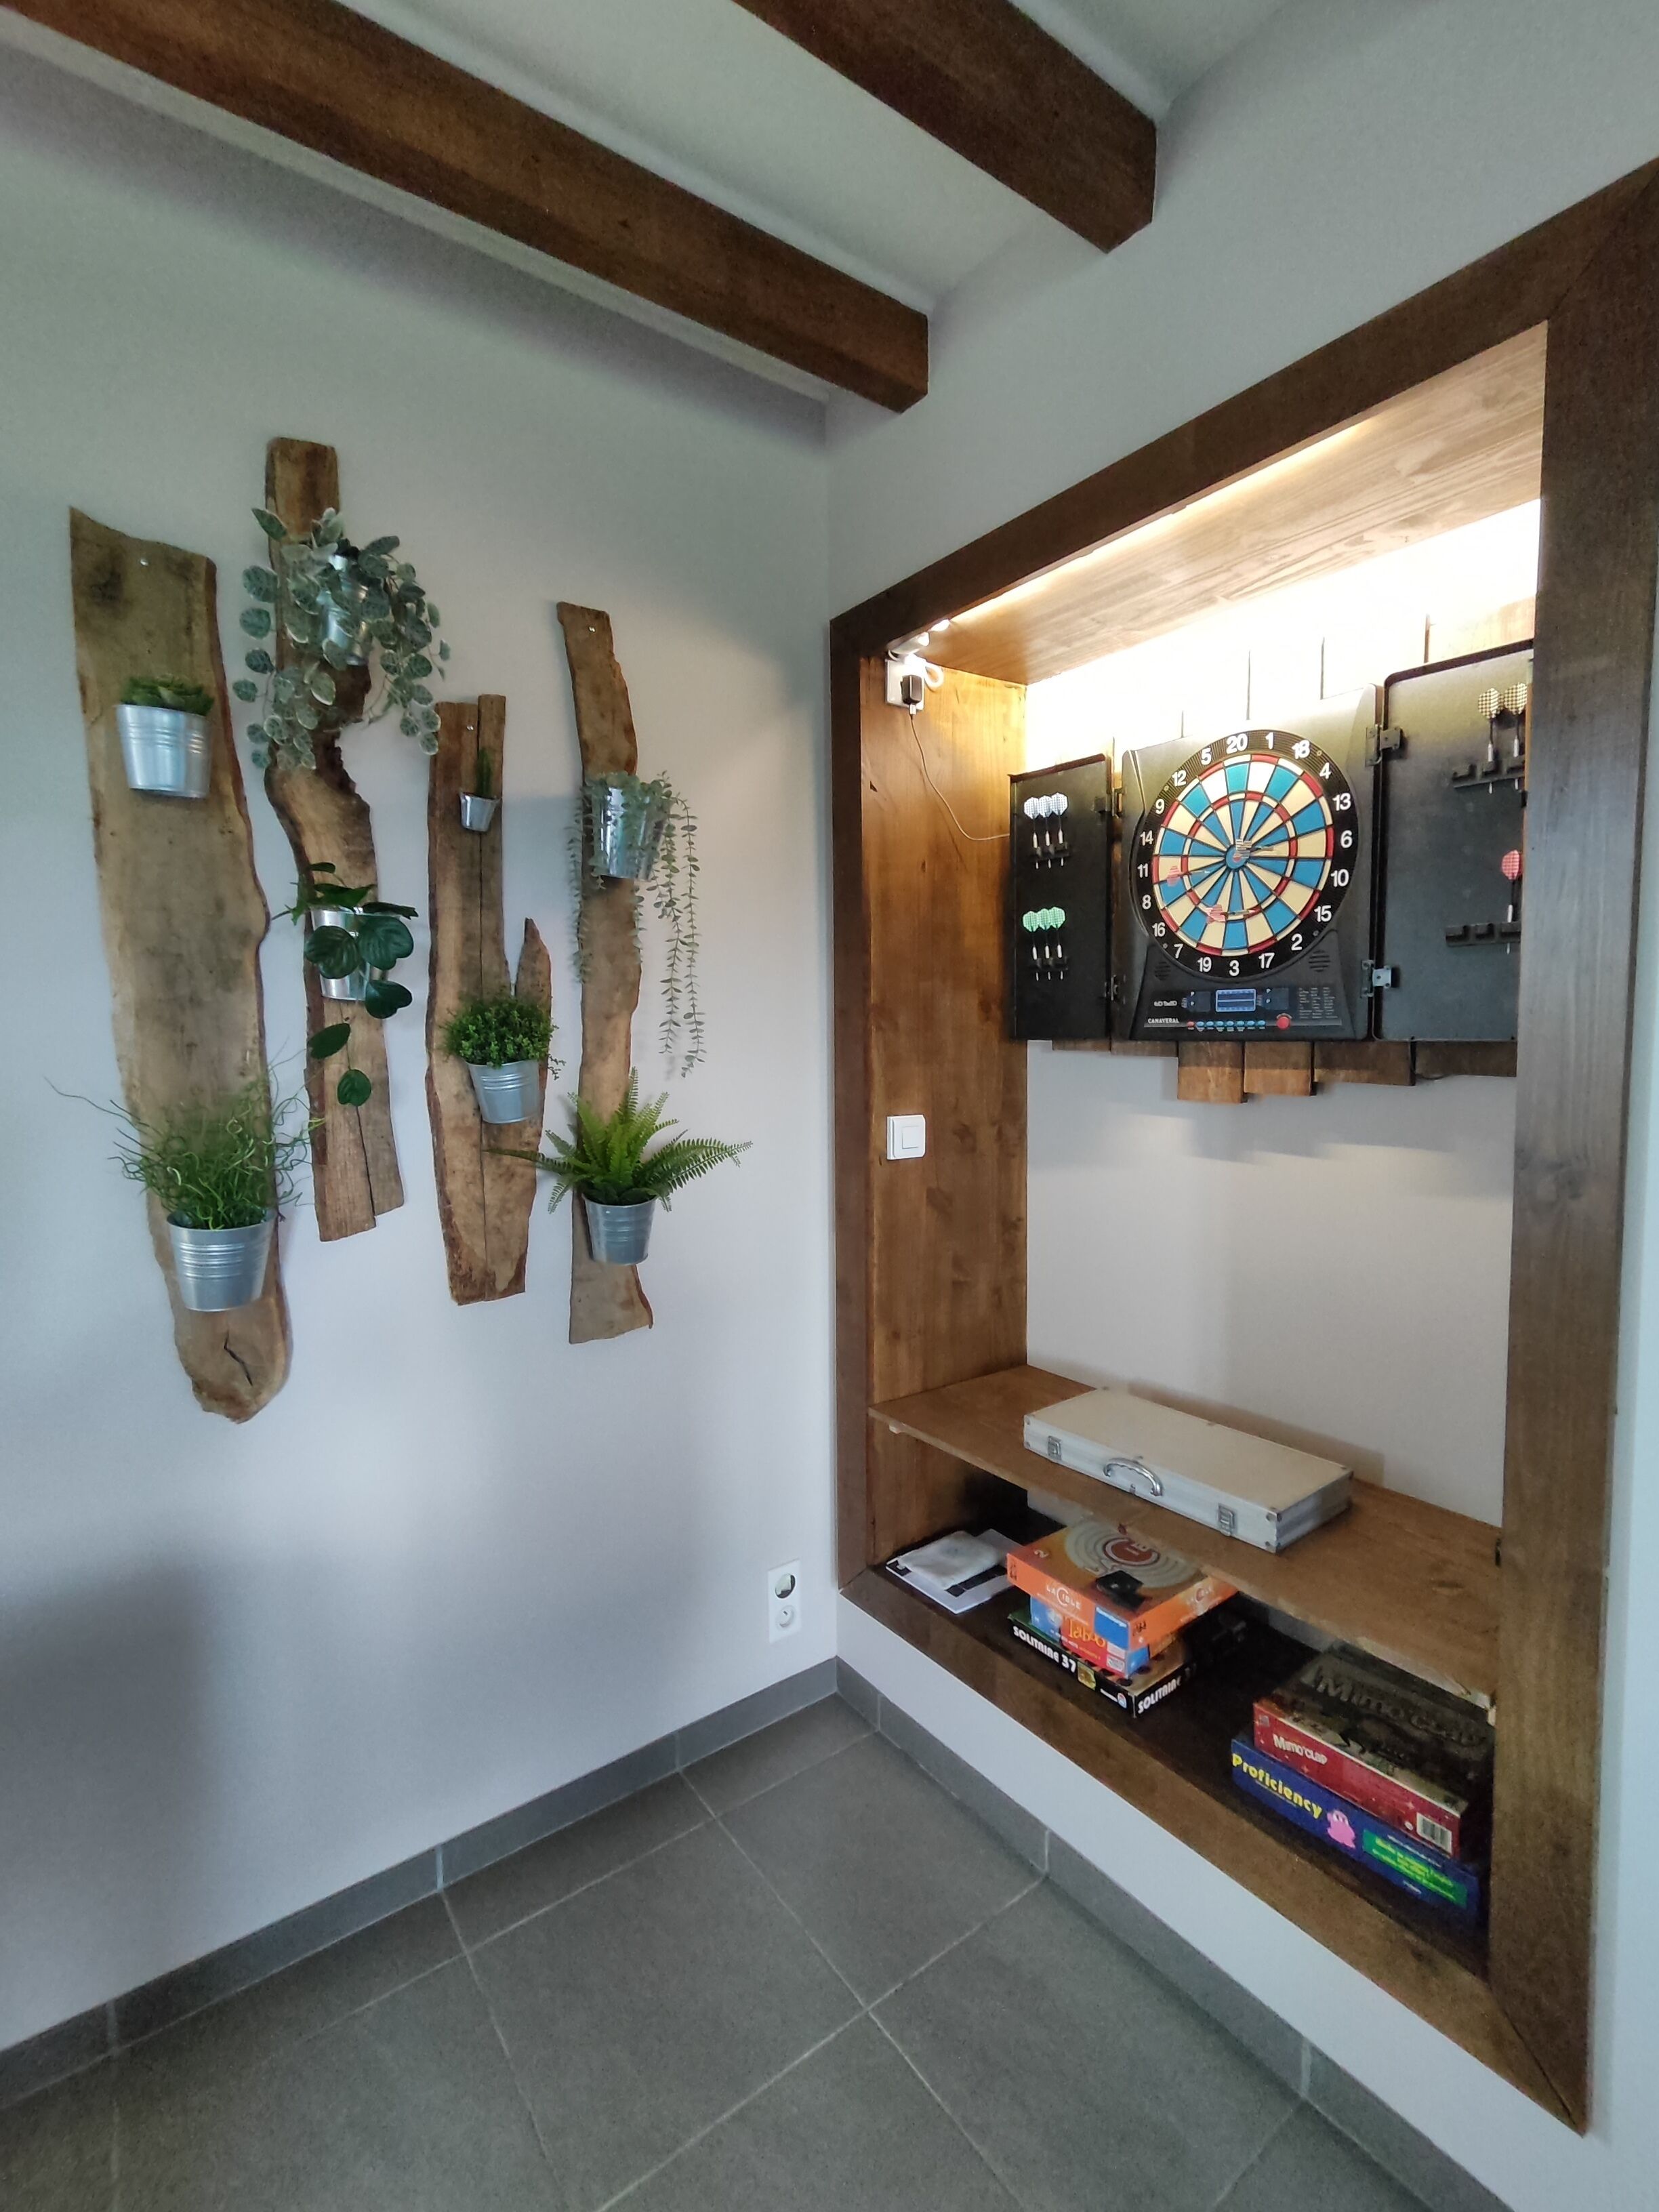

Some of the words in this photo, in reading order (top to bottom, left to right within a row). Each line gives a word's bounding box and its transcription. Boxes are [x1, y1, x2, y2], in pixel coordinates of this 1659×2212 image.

[1225, 735, 1248, 753] 20
[1265, 732, 1274, 750] 1
[1292, 740, 1311, 759] 18
[1200, 747, 1212, 765] 5
[1171, 770, 1187, 787] 12
[1319, 762, 1332, 779] 4
[1155, 798, 1165, 815] 9
[1332, 792, 1351, 811] 13
[1139, 831, 1154, 846] 14
[1340, 830, 1353, 848] 6
[1137, 863, 1149, 878] 11
[1330, 869, 1349, 887] 10
[1142, 894, 1151, 910] 8
[1313, 905, 1332, 922] 15
[1151, 922, 1166, 937] 16
[1291, 933, 1303, 951] 2
[1173, 943, 1184, 959] 7
[1197, 956, 1212, 972] 19
[1229, 960, 1240, 977] 3
[1258, 952, 1275, 969] 17
[1046, 1584, 1057, 1595] LA
[1057, 1586, 1081, 1611] CIBLE
[1012, 1626, 1060, 1664] SOLITAIRE
[1061, 1654, 1077, 1674] 37
[1231, 1753, 1323, 1820] Proficiency
